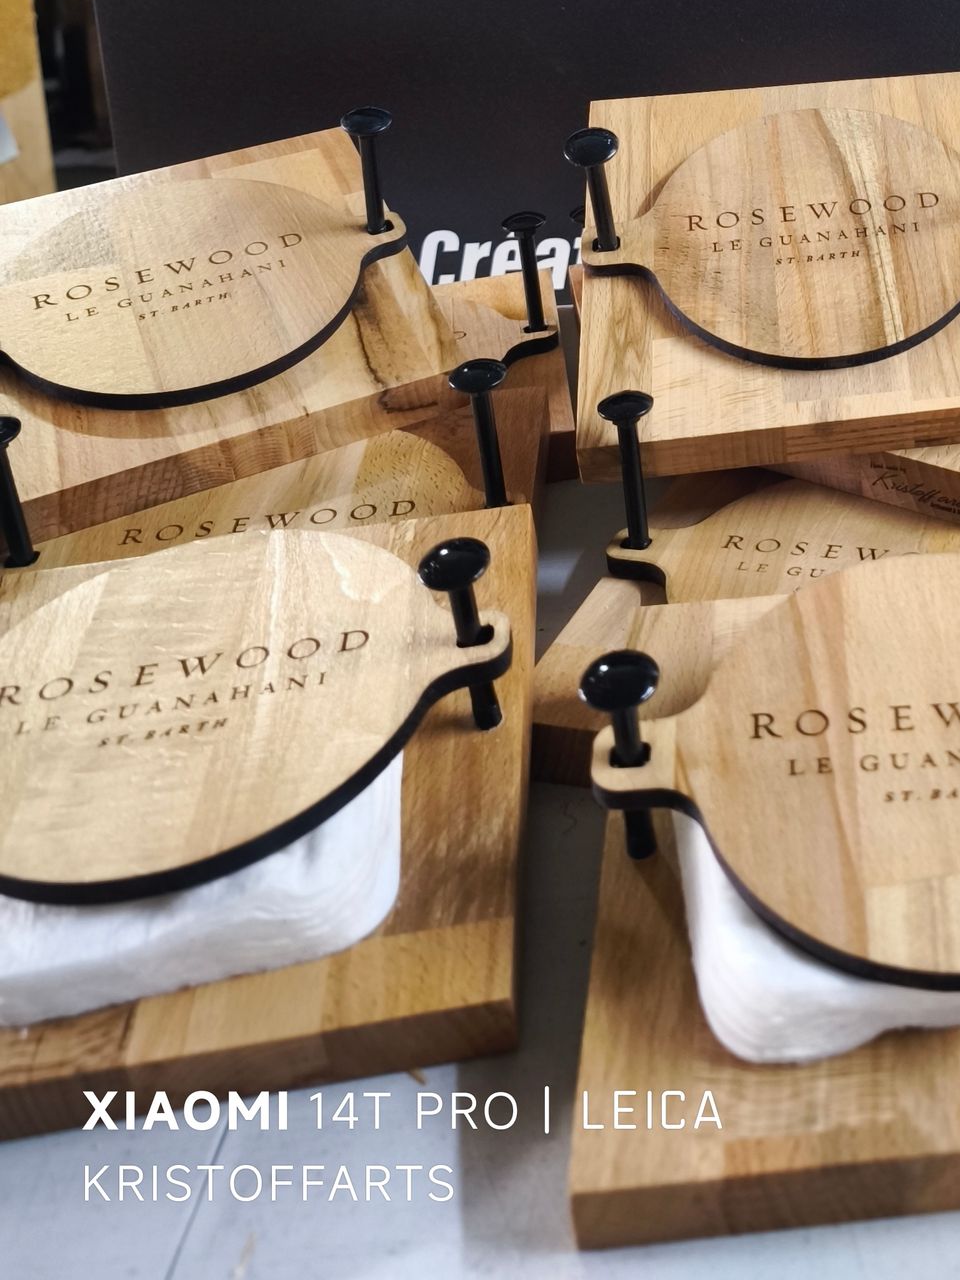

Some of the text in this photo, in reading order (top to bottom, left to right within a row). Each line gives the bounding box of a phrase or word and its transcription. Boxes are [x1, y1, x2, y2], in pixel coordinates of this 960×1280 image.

[688, 192, 940, 231] ROSEWOOD
[712, 222, 921, 253] LE GUANAHANI
[32, 233, 303, 309] ROSEWOOD
[806, 250, 861, 263] BARTH
[65, 260, 286, 322] LE GUANAHANI
[171, 293, 229, 312] BARTH
[118, 500, 416, 546] ROSEWOOD
[721, 534, 921, 561] ROSEW
[736, 561, 769, 574] LE
[0, 630, 370, 708] ROSEWOOD
[15, 671, 328, 736] LE GUANAHANI
[788, 757, 833, 776] LE
